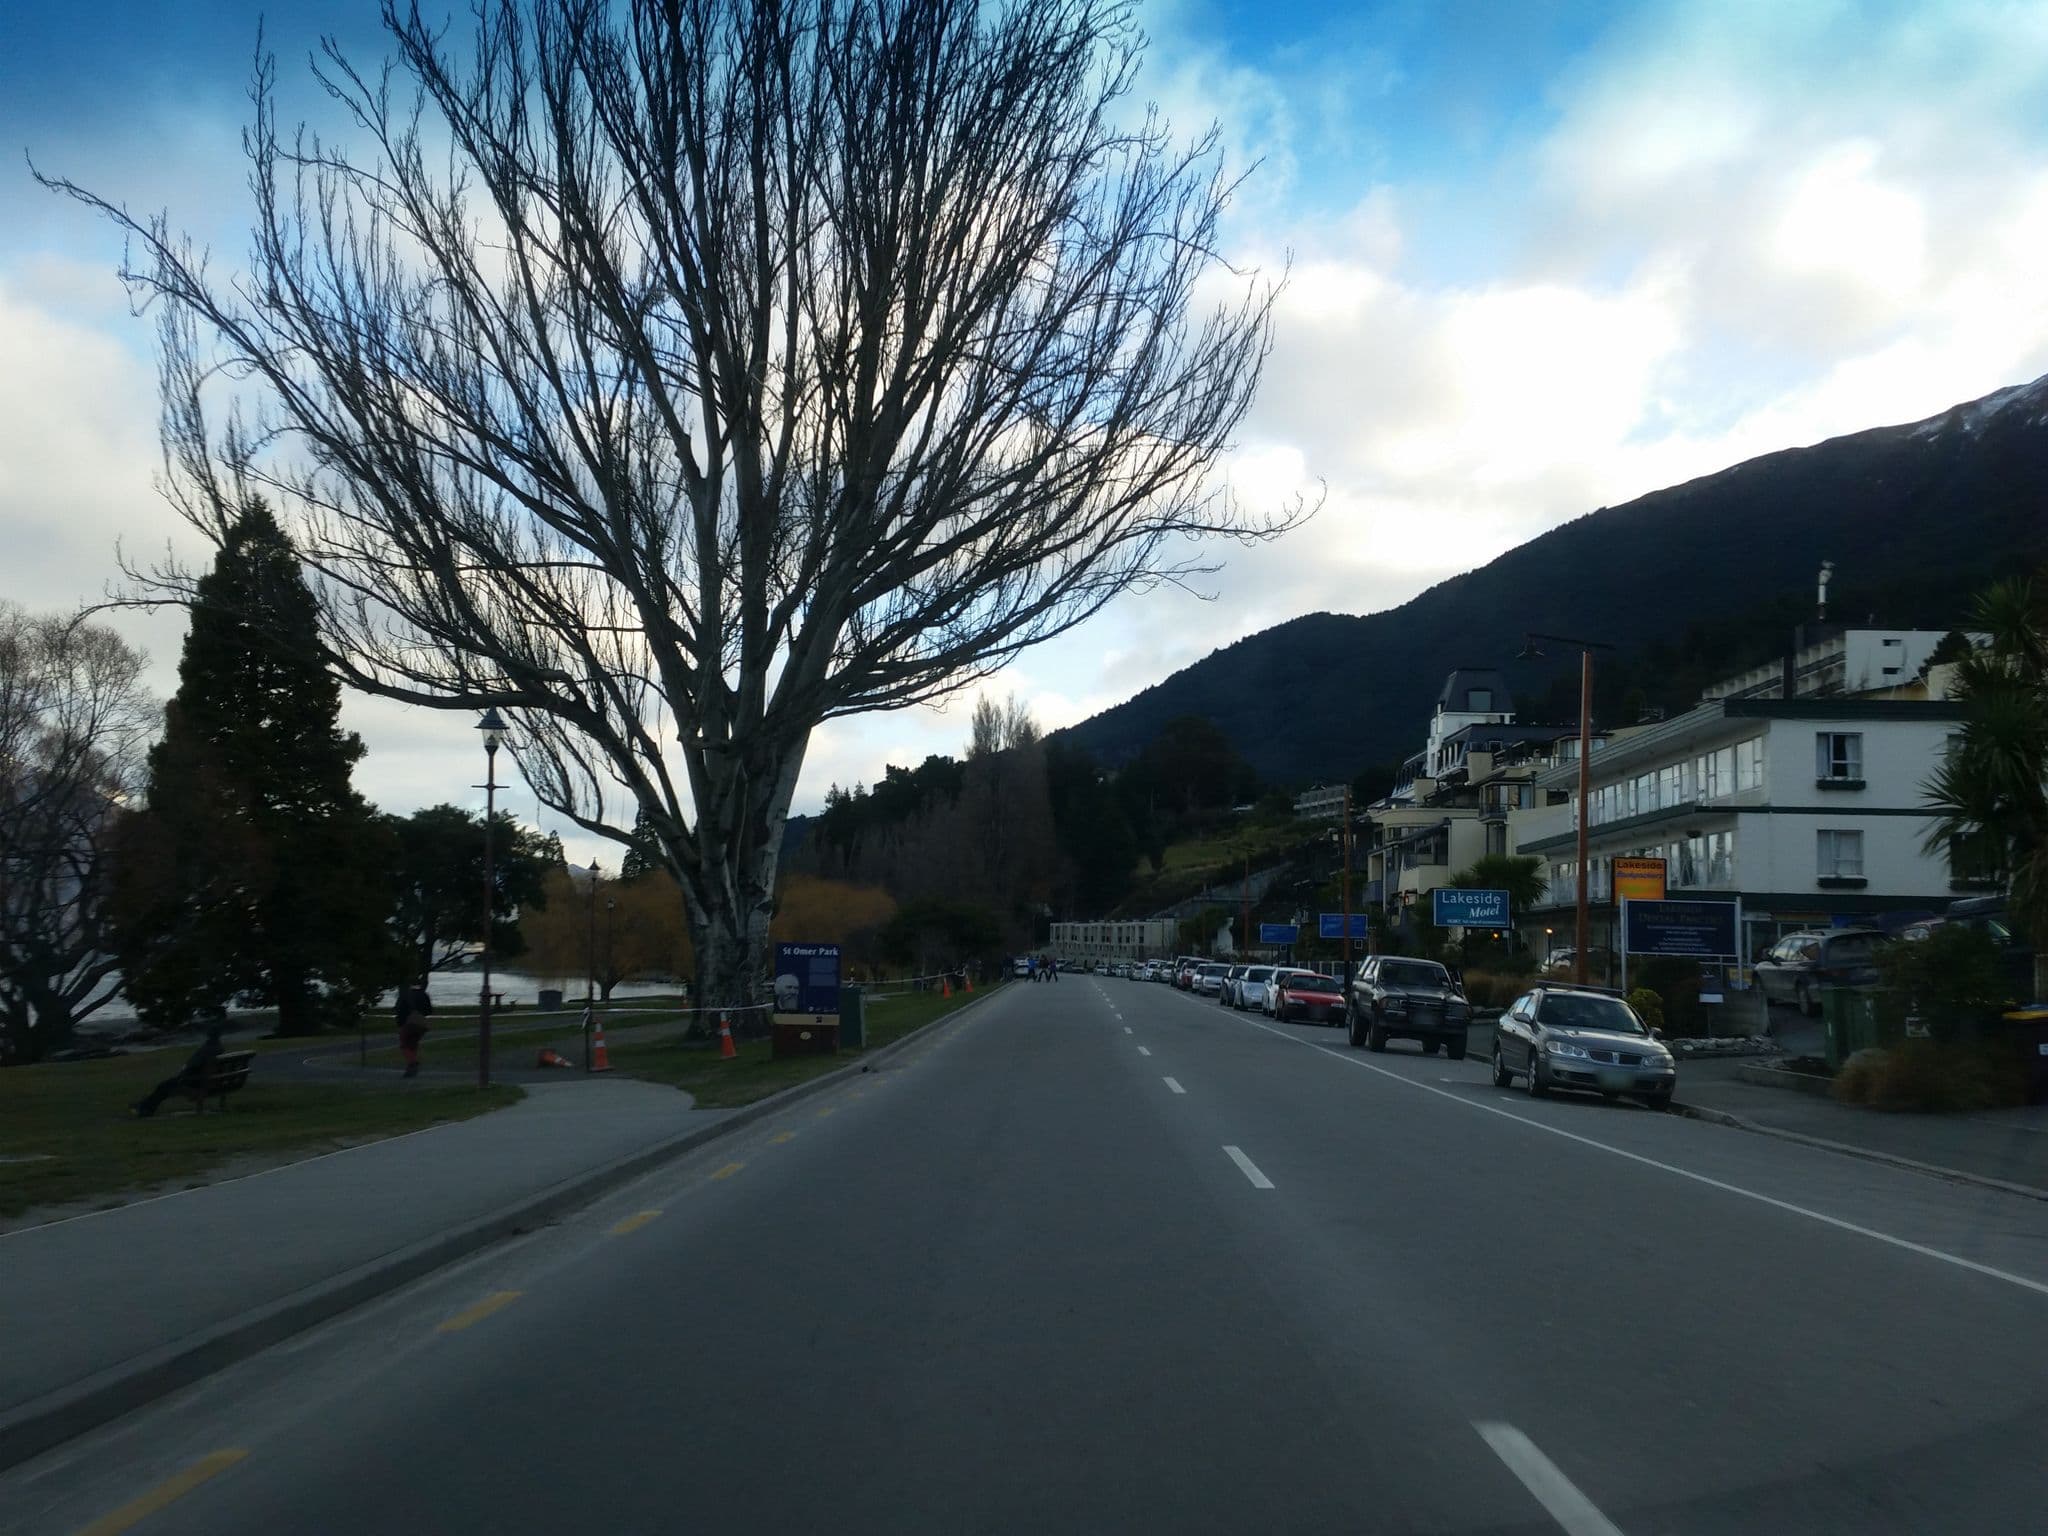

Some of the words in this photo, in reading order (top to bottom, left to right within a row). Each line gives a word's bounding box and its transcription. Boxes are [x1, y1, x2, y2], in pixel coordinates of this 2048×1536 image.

[1617, 861, 1663, 869] Lakeside
[1442, 891, 1501, 904] Lakeside
[1469, 905, 1500, 918] Motel
[783, 947, 791, 955] St
[793, 947, 817, 955] Omer
[819, 947, 839, 956] Park
